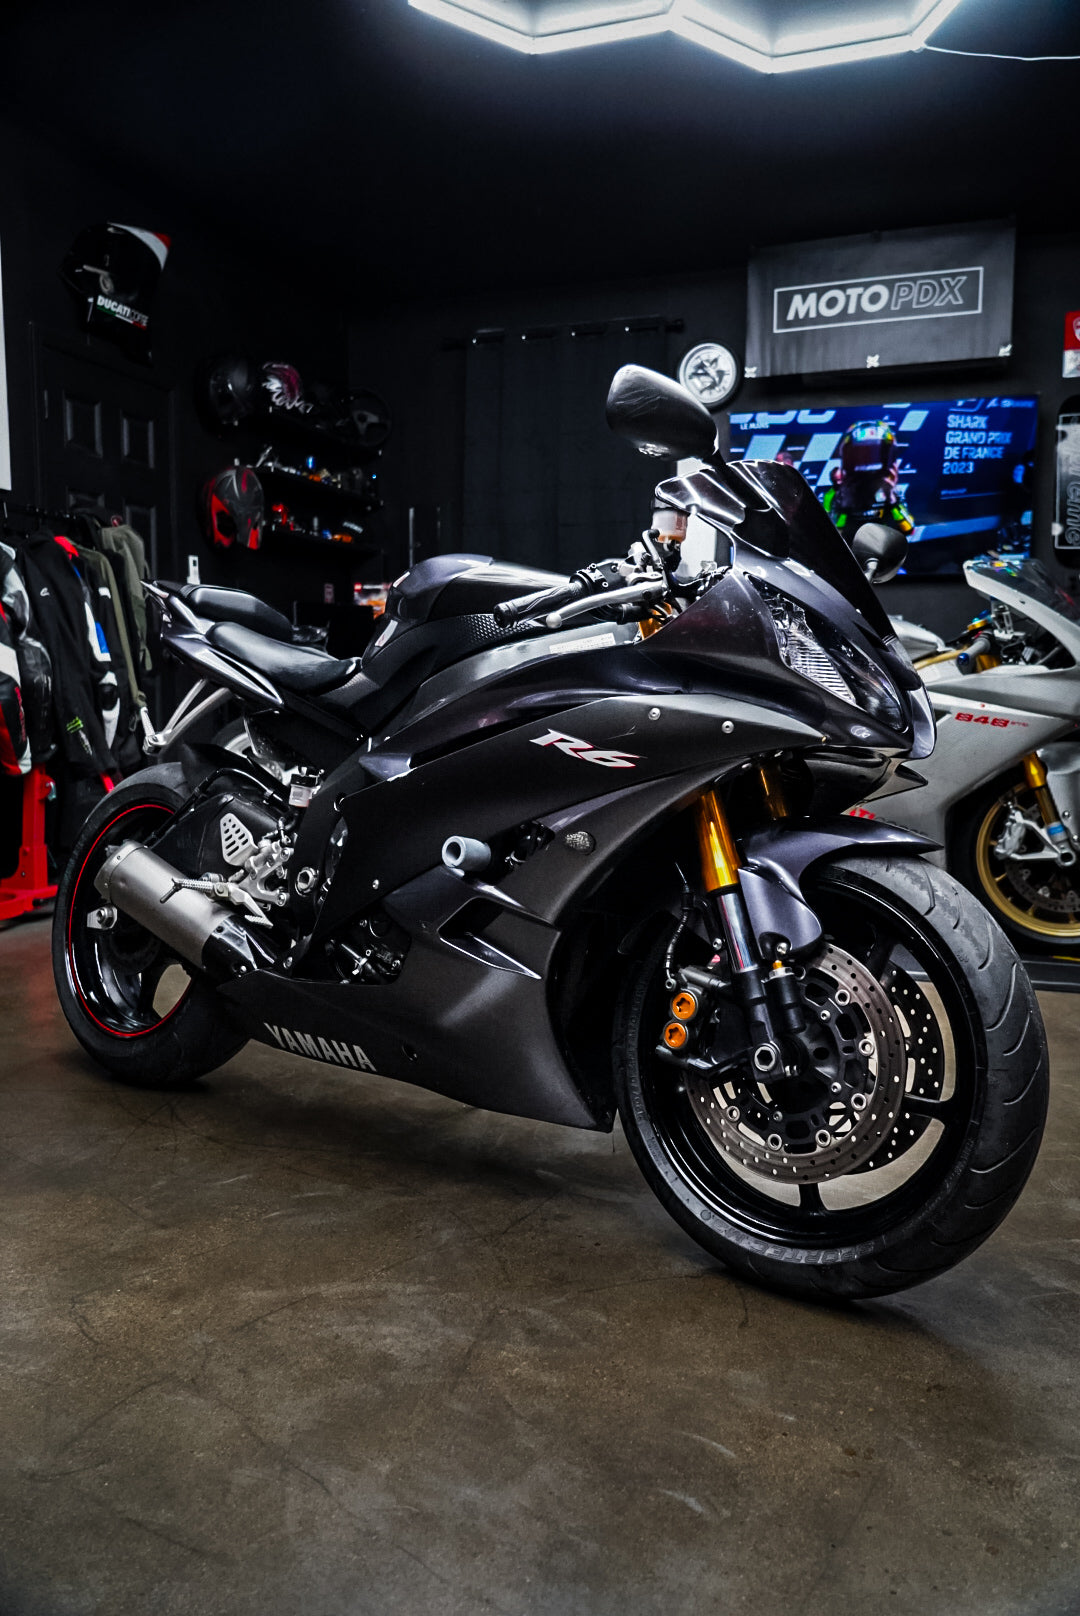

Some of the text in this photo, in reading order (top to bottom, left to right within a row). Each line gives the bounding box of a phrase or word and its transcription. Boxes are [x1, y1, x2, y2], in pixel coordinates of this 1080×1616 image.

[787, 275, 967, 320] MOTO PDX
[97, 294, 131, 318] DUCATI
[947, 414, 988, 428] SHARK
[945, 430, 986, 444] GRAND
[944, 446, 1005, 459] DE FRANCE
[942, 461, 974, 475] 2023
[955, 712, 1010, 728] 848
[529, 729, 640, 769] R6
[263, 1021, 378, 1072] YAMAHA
